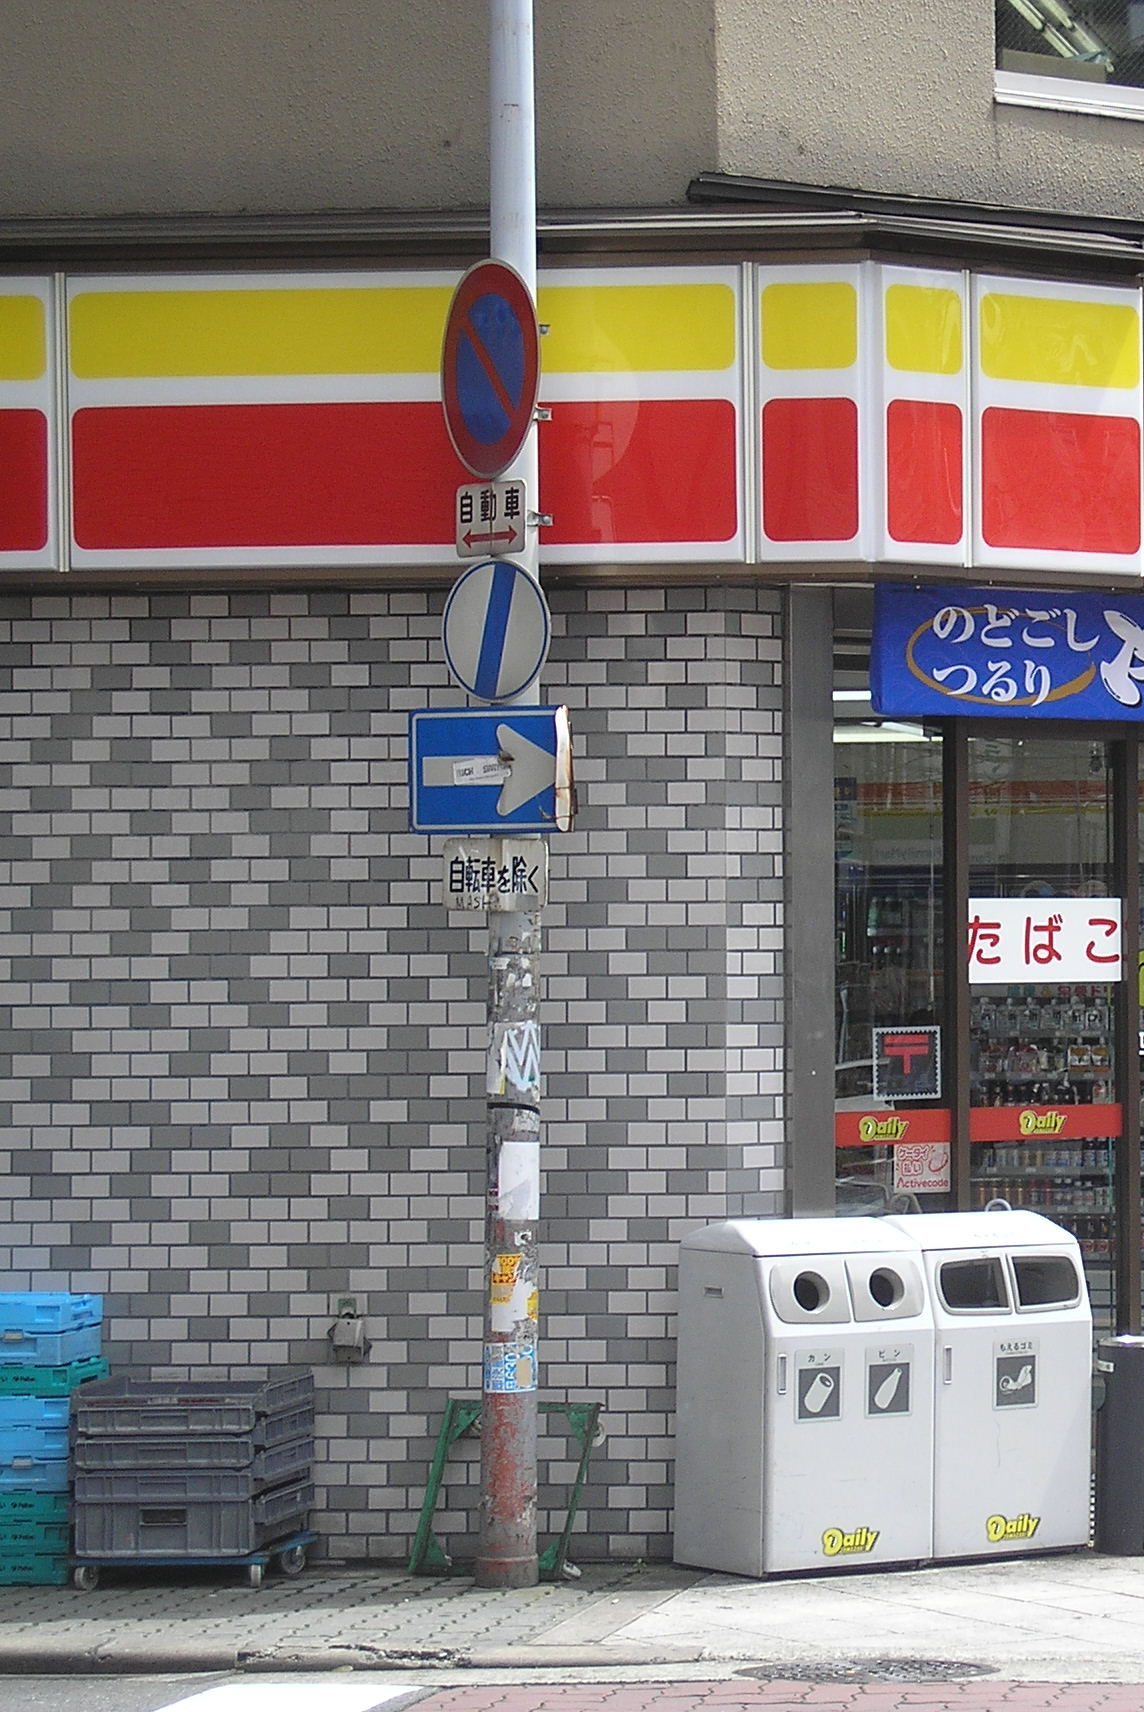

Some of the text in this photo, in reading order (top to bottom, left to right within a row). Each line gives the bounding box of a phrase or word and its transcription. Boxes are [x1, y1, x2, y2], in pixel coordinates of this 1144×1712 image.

[460, 487, 520, 525] 自動車
[931, 605, 1098, 653] のどごし
[932, 659, 1052, 707] つるり
[450, 856, 539, 893] 自転車を除く
[968, 914, 1121, 966] たばこ
[859, 1116, 908, 1141] Daily
[1019, 1111, 1067, 1135] Daily
[896, 1177, 949, 1188] Activecode
[822, 1527, 879, 1556] Daily
[986, 1514, 1040, 1542] Daily
